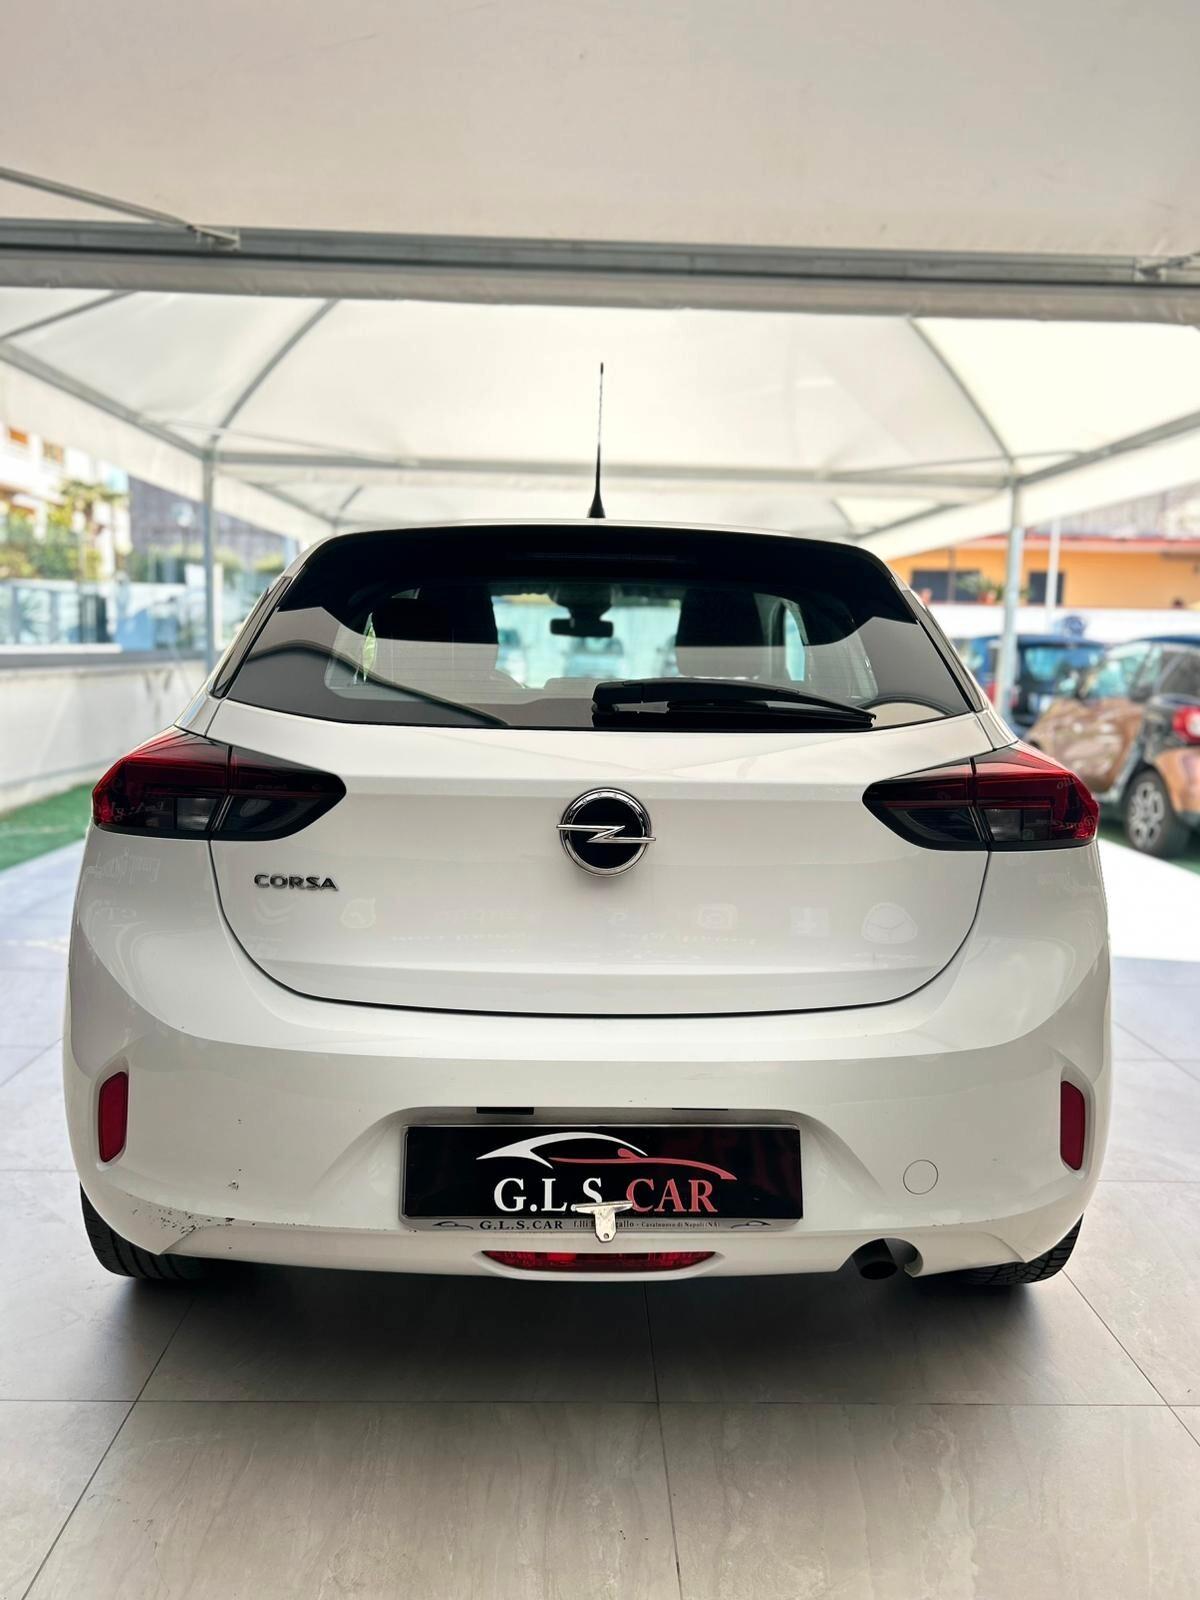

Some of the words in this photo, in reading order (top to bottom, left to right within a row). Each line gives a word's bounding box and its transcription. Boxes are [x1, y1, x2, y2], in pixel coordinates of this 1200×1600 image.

[254, 874, 338, 891] CORSA
[626, 1178, 718, 1213] CAR
[479, 1220, 563, 1231] G.L.S.CAR
